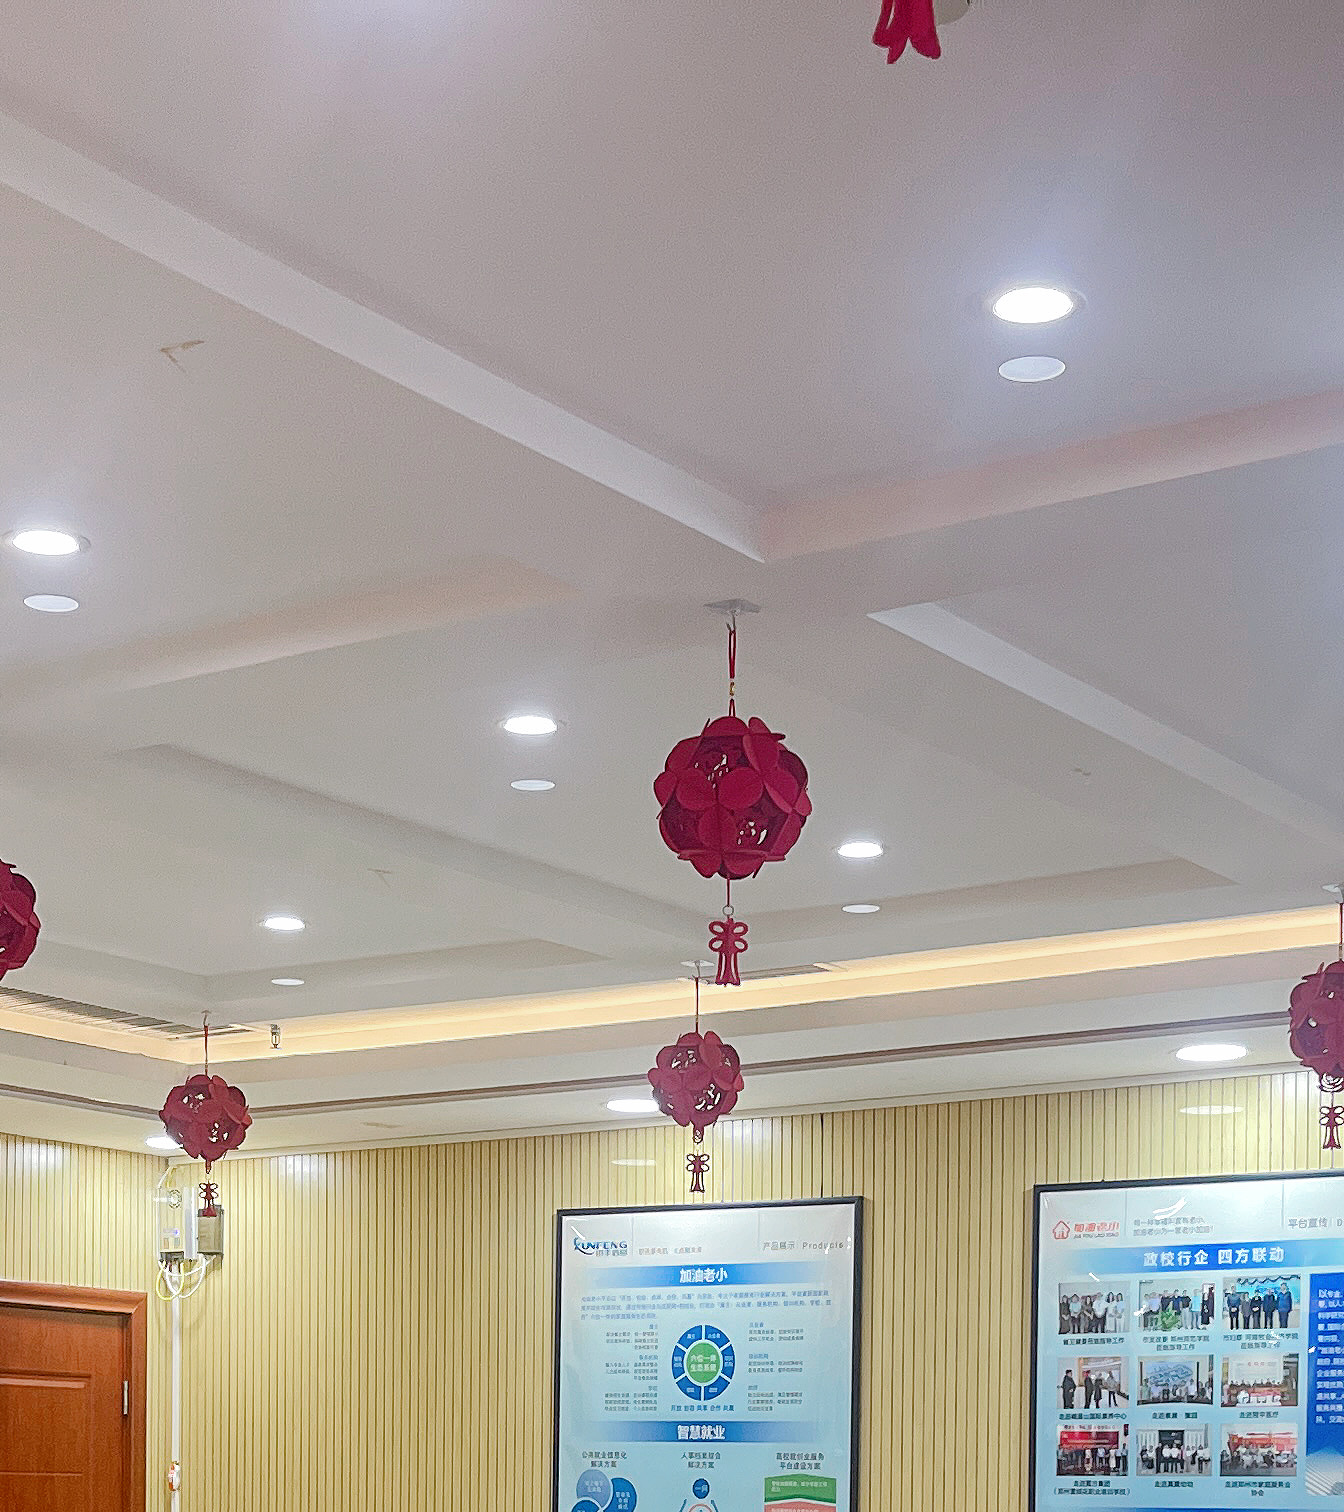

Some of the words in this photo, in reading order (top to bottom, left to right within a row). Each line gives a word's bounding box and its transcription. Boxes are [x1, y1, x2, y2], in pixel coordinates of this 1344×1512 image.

[1143, 1249, 1209, 1267] 政校行企
[1217, 1246, 1285, 1265] 四方联动
[679, 1267, 728, 1284] 加油老小
[677, 1424, 726, 1441] 智慧就业
